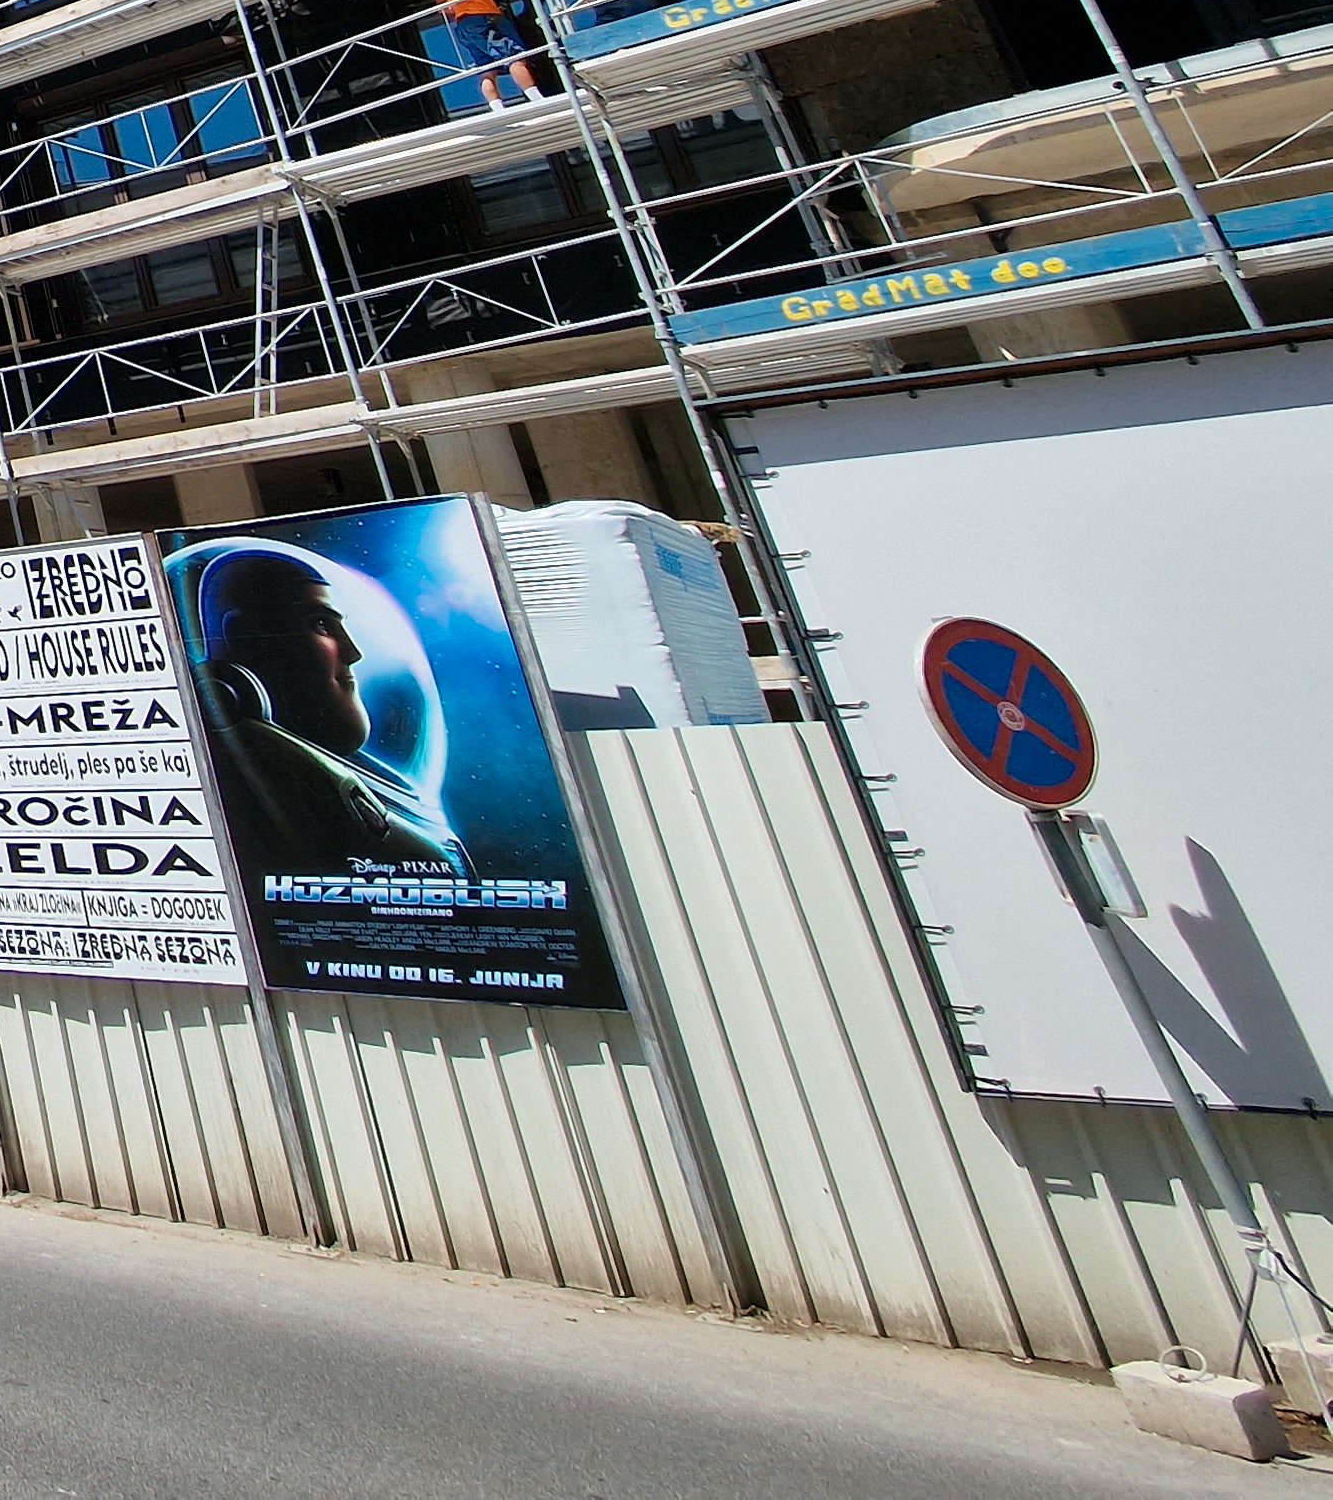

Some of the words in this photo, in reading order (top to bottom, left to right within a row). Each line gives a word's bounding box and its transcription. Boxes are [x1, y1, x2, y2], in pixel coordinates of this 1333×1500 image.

[782, 270, 971, 323] GradMat
[15, 635, 20, 680] /
[25, 628, 98, 679] HOUSE
[97, 623, 166, 675] RULES
[10, 752, 74, 780] štrudelj,
[77, 751, 110, 781] ples
[114, 756, 136, 779] pa
[140, 749, 158, 773] še
[163, 748, 192, 778] kaj
[347, 857, 396, 877] Disney
[403, 861, 453, 875] PIXAR
[88, 896, 139, 918] KNJIGA
[141, 904, 148, 915] =
[151, 897, 225, 920] DOGODEK
[264, 875, 567, 909] KOZMOBLISK
[371, 906, 453, 918] SINHRONIZIRANO
[72, 932, 152, 961] IZREDNA
[154, 935, 236, 966] SEZONA
[306, 961, 320, 975] V
[328, 963, 381, 979] KINU
[389, 966, 422, 981] OD
[429, 967, 462, 985] 16.
[469, 969, 563, 990] JUNIJA
